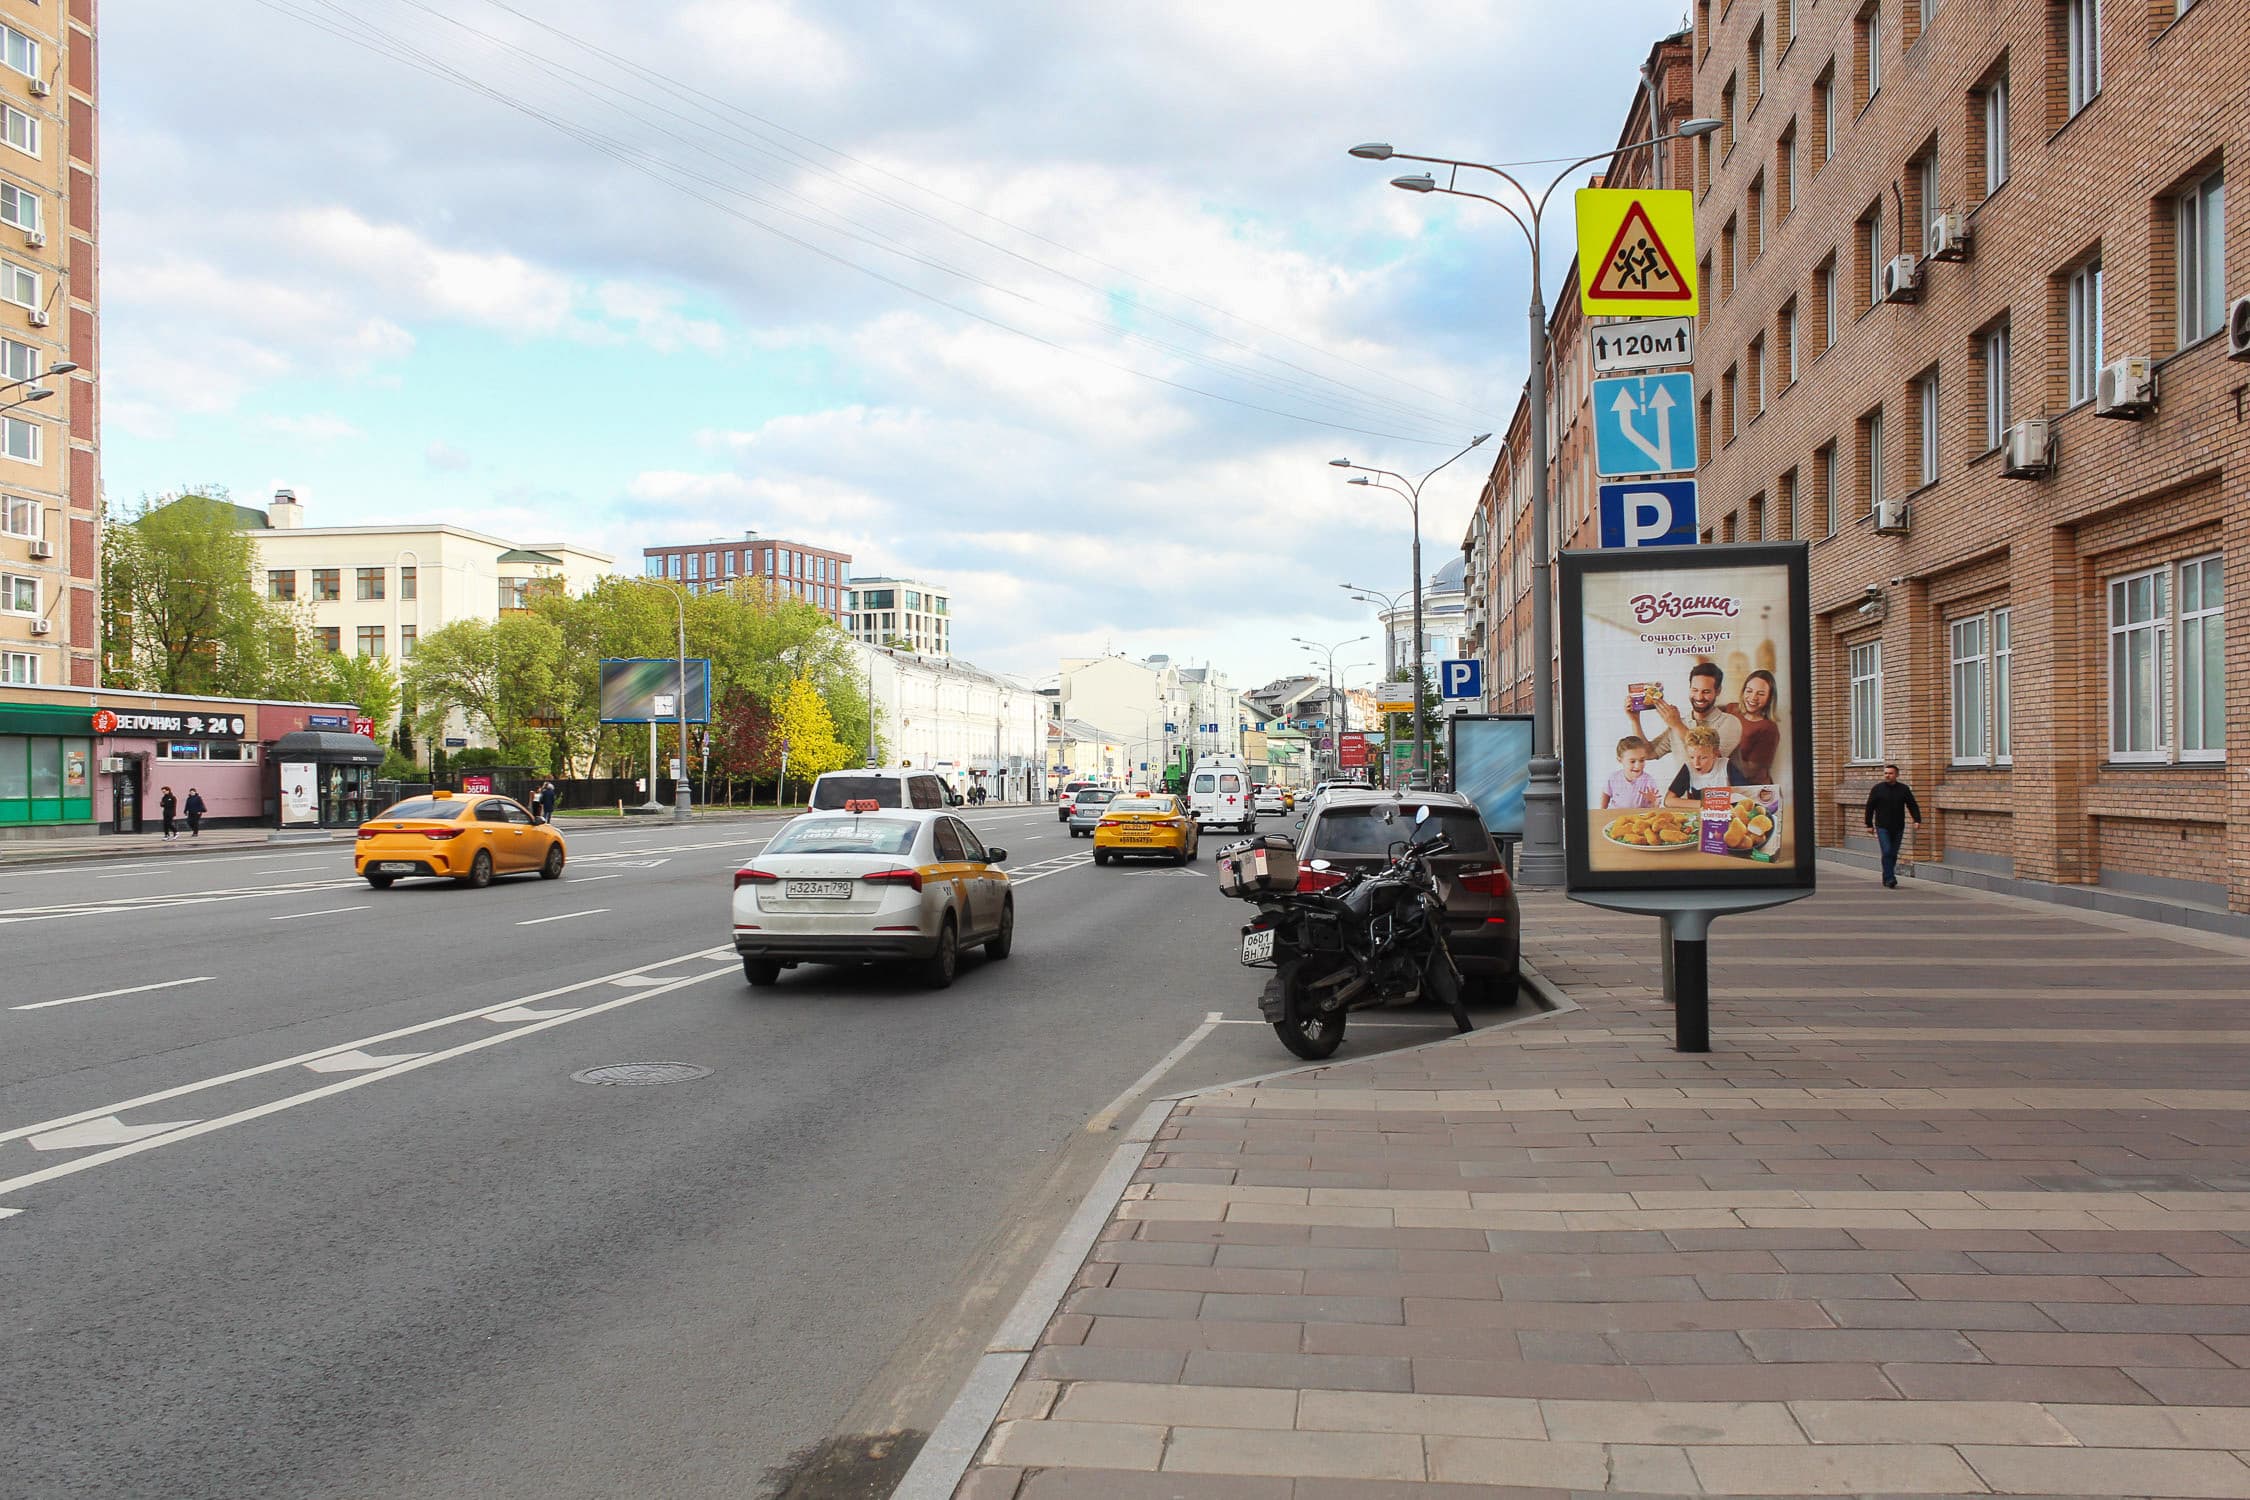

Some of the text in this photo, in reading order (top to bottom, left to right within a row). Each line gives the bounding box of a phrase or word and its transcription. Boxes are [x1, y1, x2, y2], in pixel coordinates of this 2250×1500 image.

[1622, 492, 1672, 548] P
[1630, 591, 1739, 624] Вязанка
[1700, 632, 1731, 643] хруст
[1657, 644, 1715, 656] и улыбки!
[1451, 664, 1471, 695] P
[115, 714, 181, 731] ВЕТОЧНАЯ
[208, 718, 228, 734] 24
[356, 724, 370, 735] 24
[1248, 932, 1269, 946] 0601
[1259, 946, 1270, 957] 77
